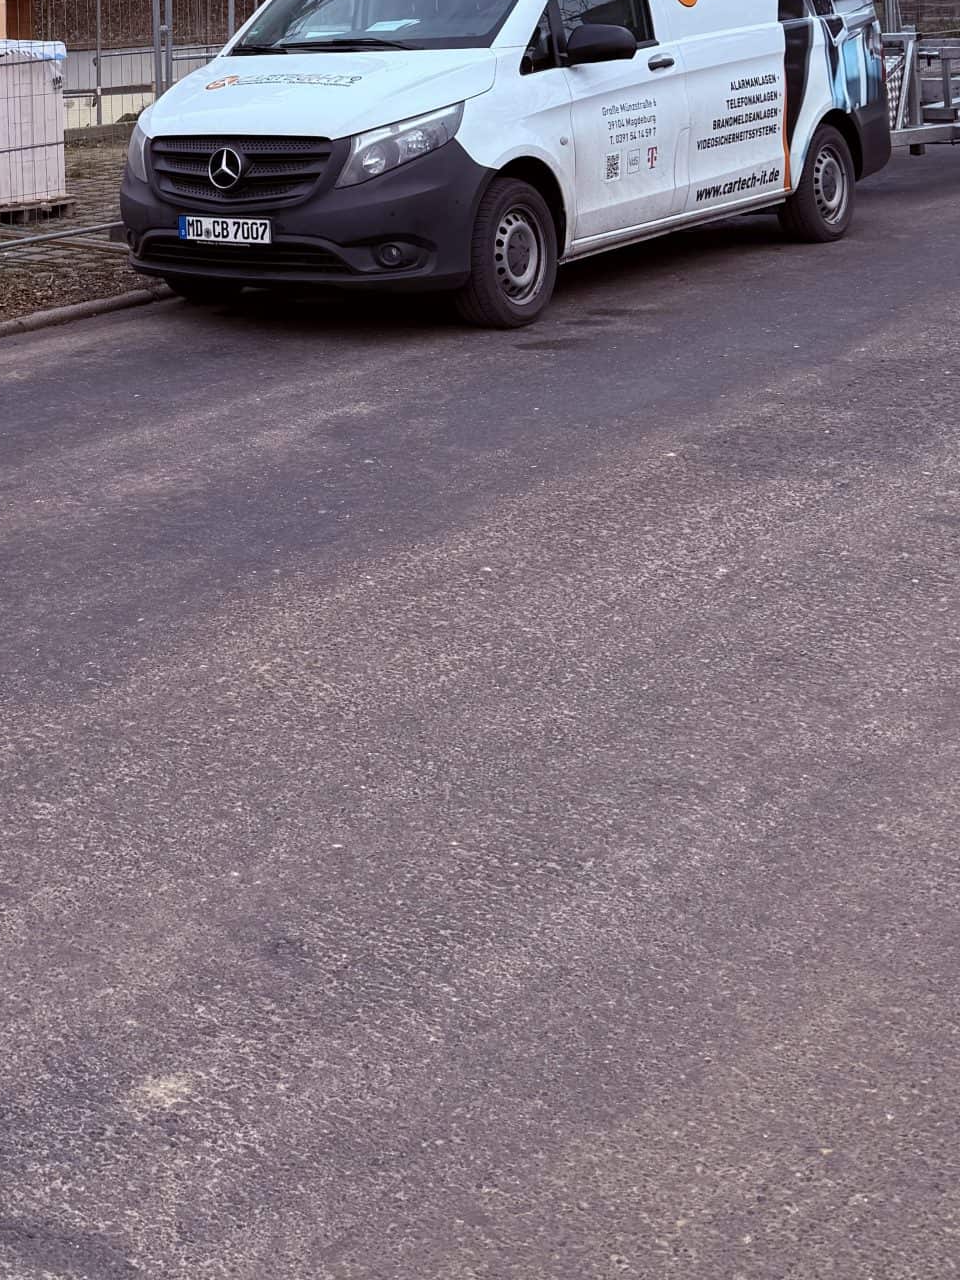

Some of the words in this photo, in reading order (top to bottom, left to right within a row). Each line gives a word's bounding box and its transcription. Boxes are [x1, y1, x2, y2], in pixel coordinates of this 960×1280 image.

[730, 74, 777, 91] ALARMANLAGEN
[726, 91, 778, 110] TELEFONANLAGEN
[713, 108, 778, 131] BRANDMELDEANLAGEN
[697, 124, 777, 151] VIDEOSICHERHEITSSYSTEME
[696, 168, 780, 202] www.cartech-it.de
[187, 220, 203, 237] MD
[213, 220, 229, 239] CB
[233, 221, 268, 240] 7007
